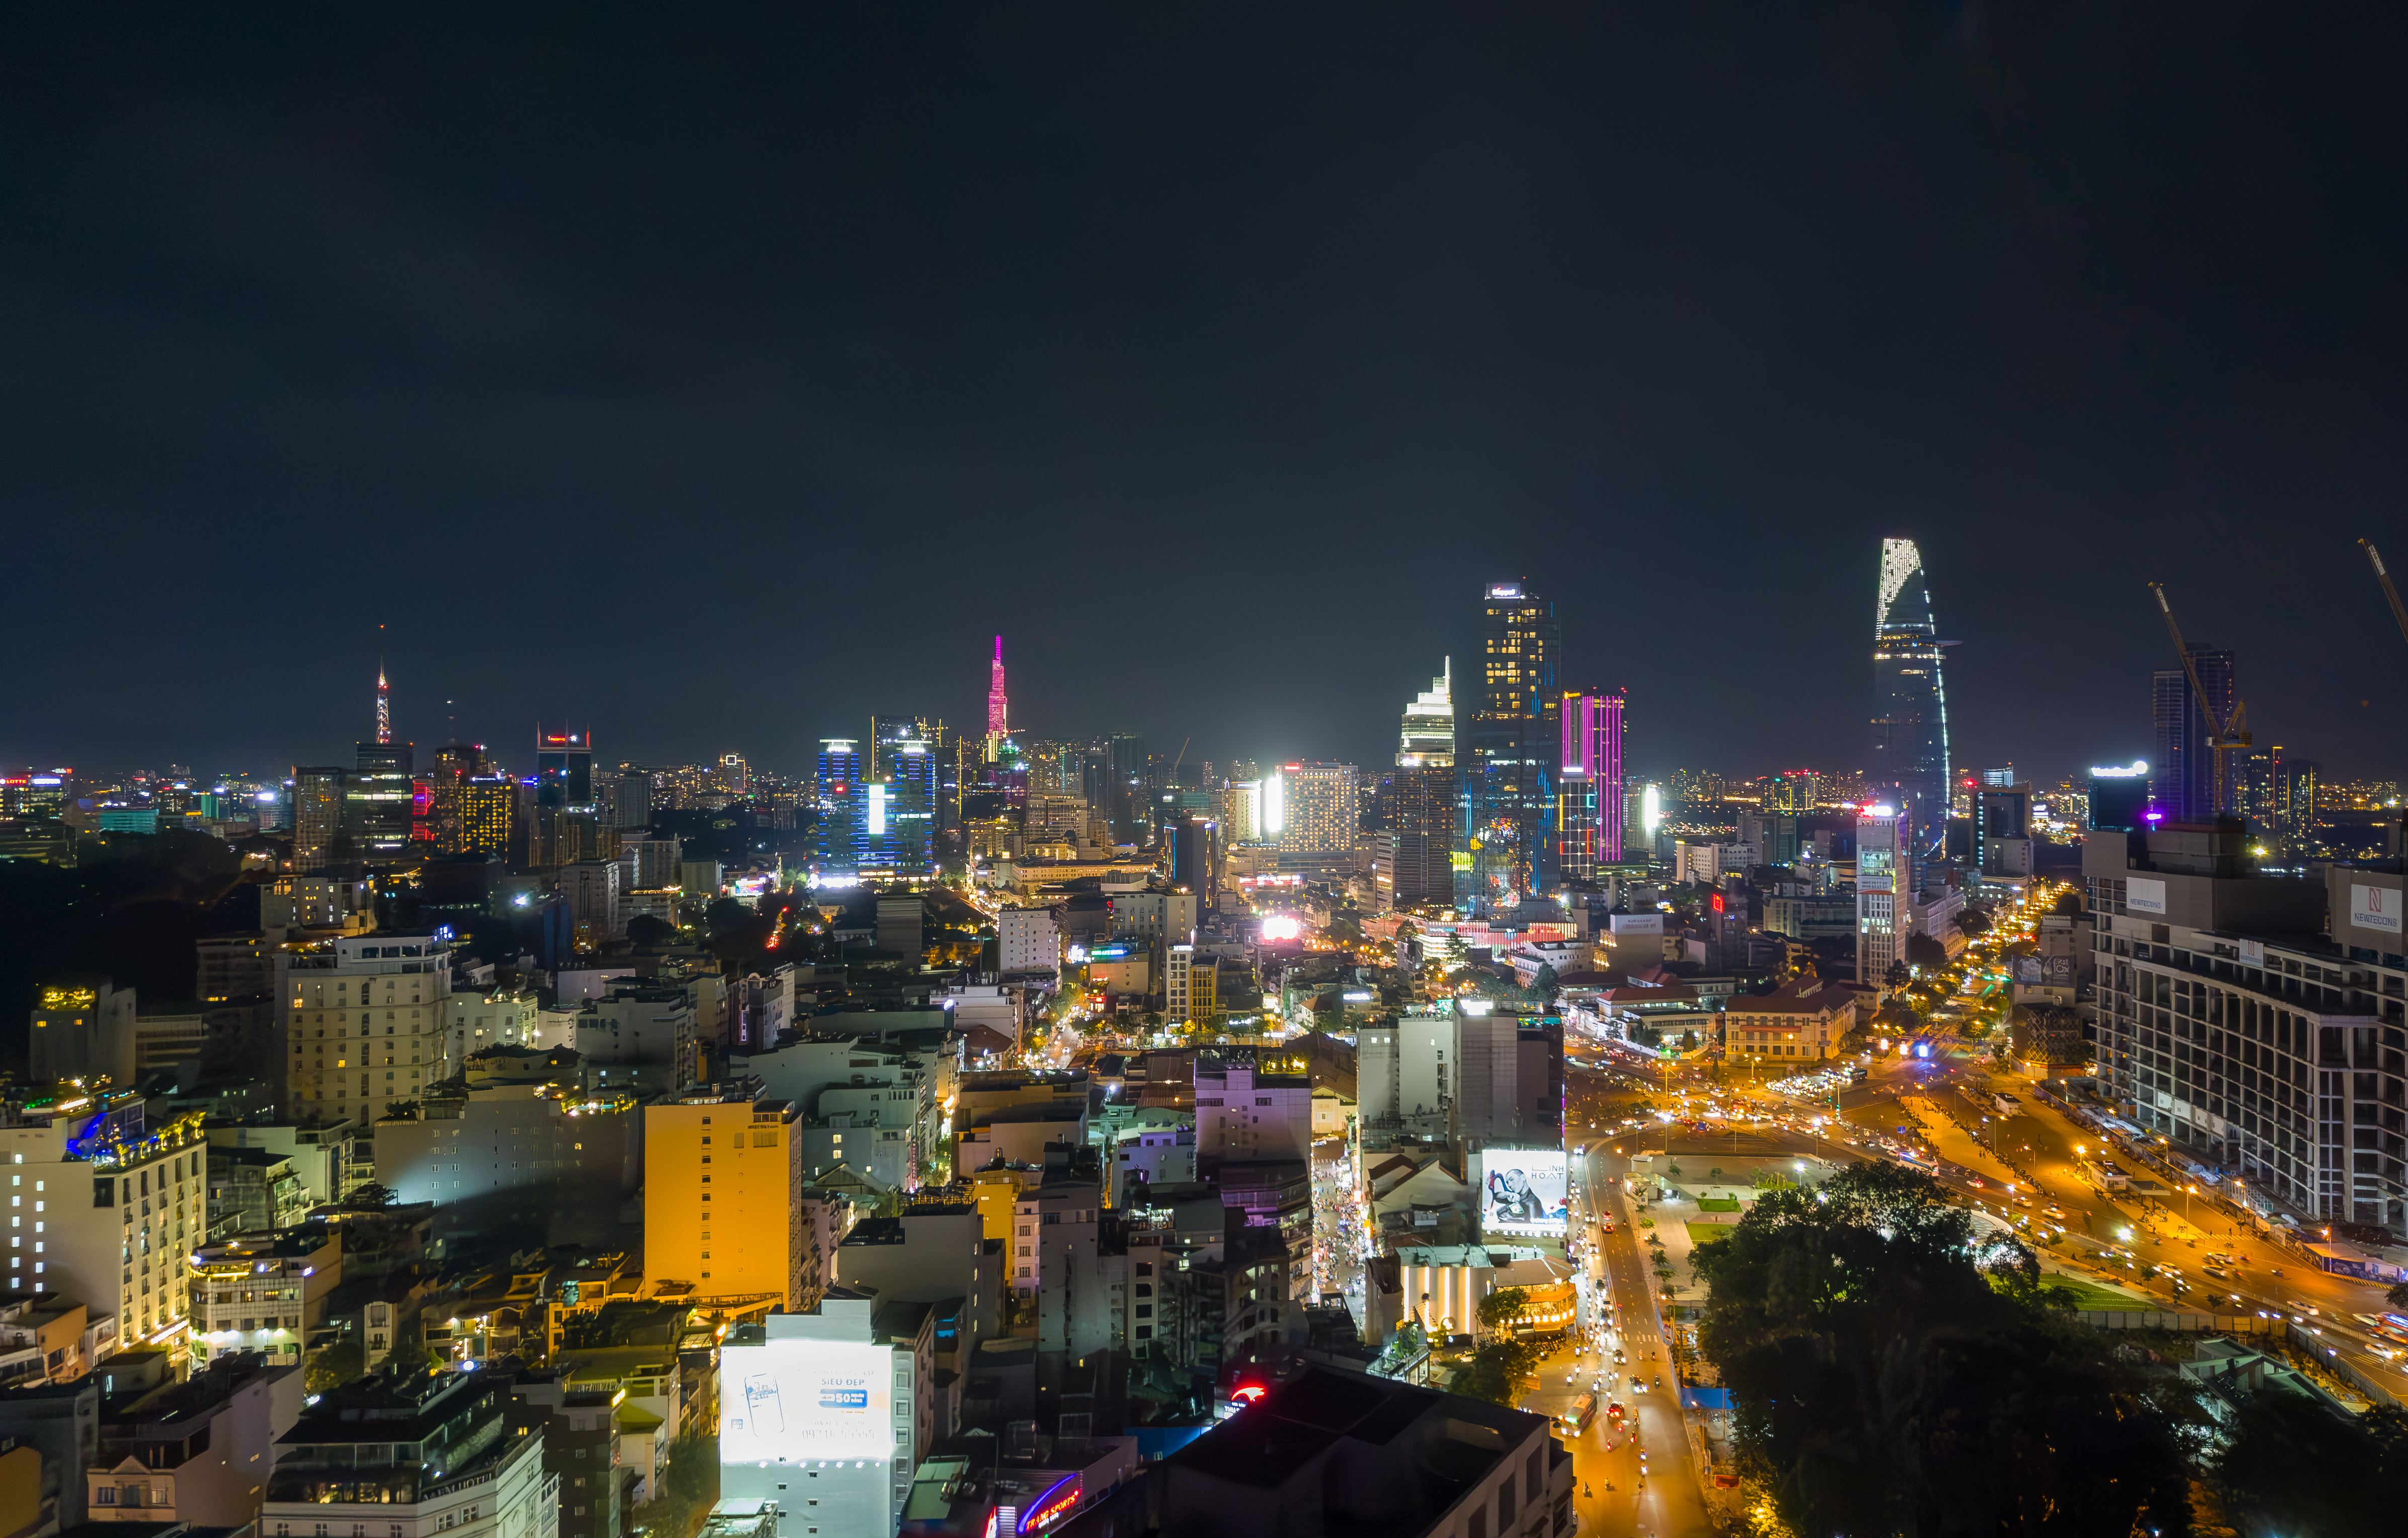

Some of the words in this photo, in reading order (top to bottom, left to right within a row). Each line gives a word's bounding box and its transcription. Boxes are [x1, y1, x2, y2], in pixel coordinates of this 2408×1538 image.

[2354, 912, 2397, 927] NEWTECONS
[836, 1393, 851, 1403] 50
[1026, 1510, 1050, 1530] TRANG
[1050, 1494, 1076, 1516] SPORTS
